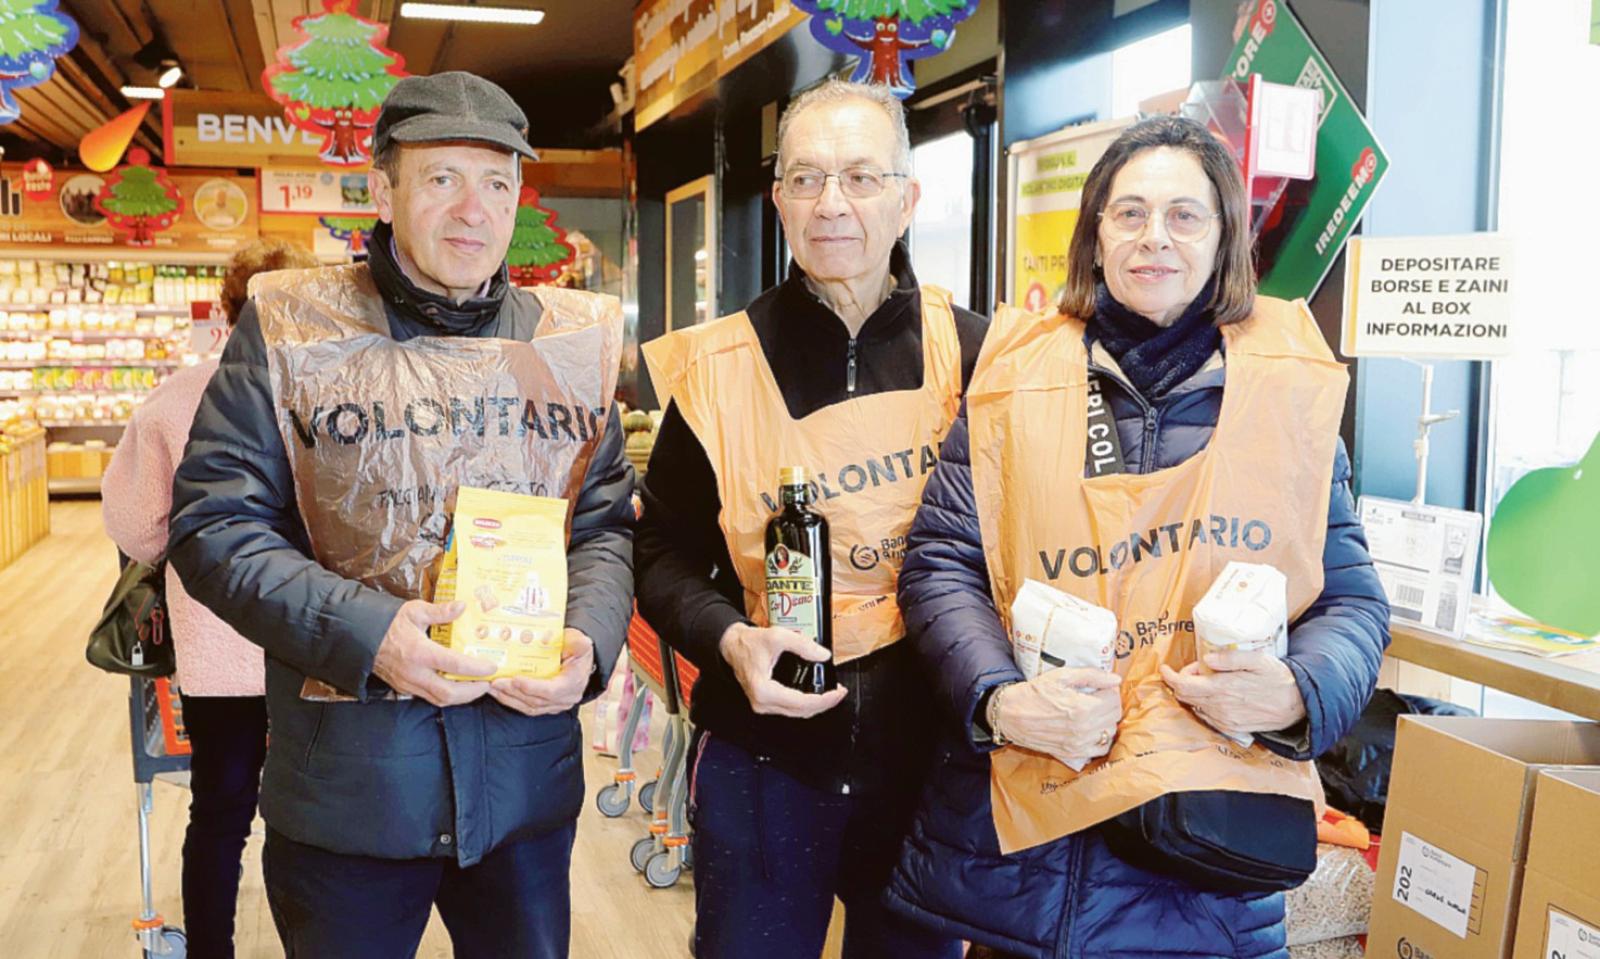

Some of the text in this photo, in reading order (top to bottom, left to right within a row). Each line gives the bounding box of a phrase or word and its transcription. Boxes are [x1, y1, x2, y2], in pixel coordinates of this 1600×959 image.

[1381, 257, 1500, 272] DEPOSITARE
[1371, 279, 1509, 293] BORSE E ZAINI
[1402, 302, 1471, 315] AL BOX
[1366, 322, 1507, 338] INFORMAZIONI
[1088, 423, 1116, 473] COL
[1039, 514, 1272, 580] VOLONTARIO
[1396, 865, 1412, 902] 202
